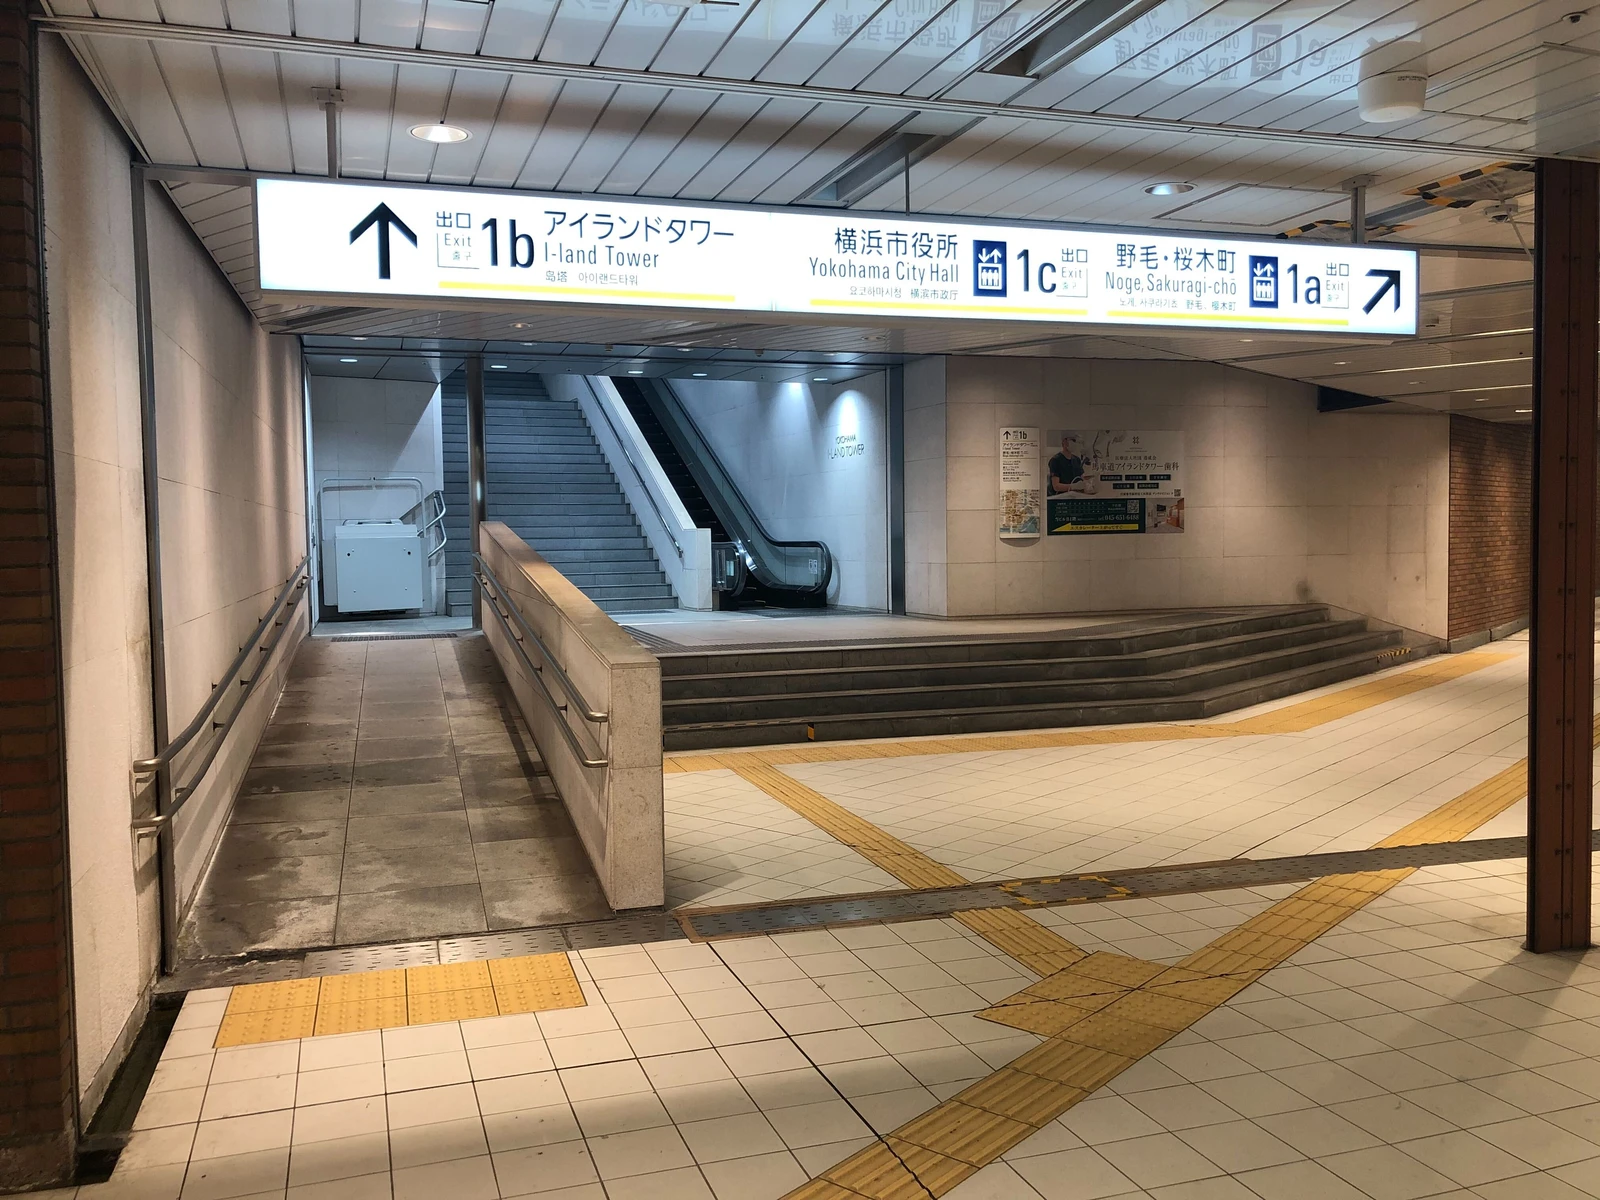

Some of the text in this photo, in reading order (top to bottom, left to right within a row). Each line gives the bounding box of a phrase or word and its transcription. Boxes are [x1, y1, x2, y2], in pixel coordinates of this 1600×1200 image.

[436, 211, 471, 229] 出口
[544, 210, 735, 246] アイランドタワー
[444, 233, 471, 247] Exit
[482, 218, 534, 268] 1b
[834, 226, 959, 261] 横浜市役所
[545, 242, 659, 268] I-land Tower
[1061, 248, 1088, 263] 出口
[1116, 243, 1237, 274] 野毛・桜木町
[546, 270, 568, 283] 岛塔
[809, 256, 959, 285] Yokohama City Hall
[1016, 249, 1057, 293] 1c
[1062, 266, 1082, 279] Exit
[1326, 262, 1349, 277] 出口
[579, 272, 638, 286] 아이랜드타워
[1287, 263, 1321, 304] 1a
[1326, 280, 1344, 291] Exit
[850, 286, 902, 299] 요코하마시청
